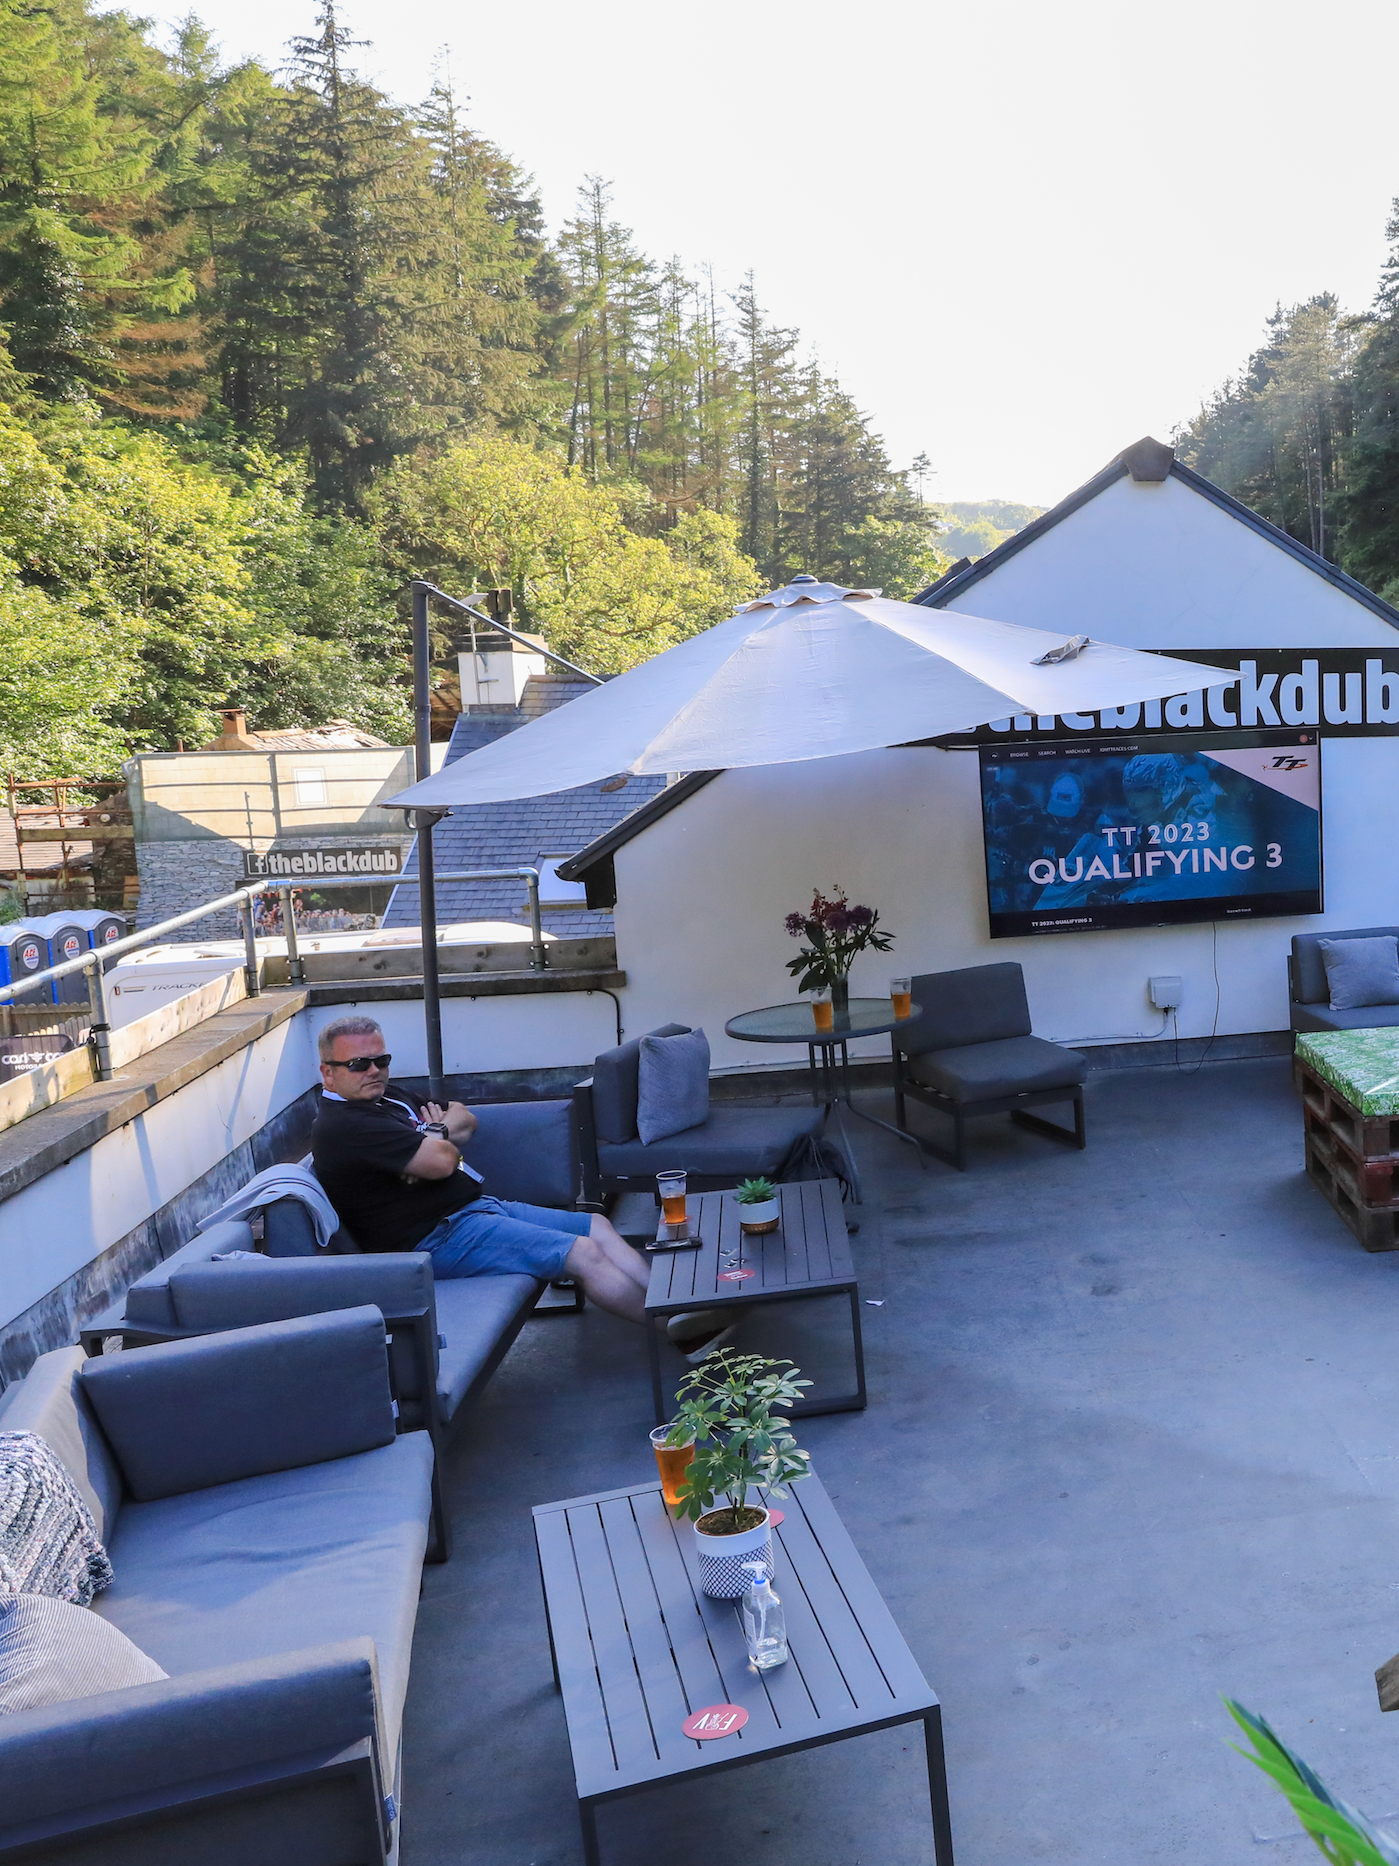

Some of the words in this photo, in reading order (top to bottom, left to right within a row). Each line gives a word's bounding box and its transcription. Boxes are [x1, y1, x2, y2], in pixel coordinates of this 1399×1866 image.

[1101, 826, 1137, 847] TT
[1147, 821, 1210, 845] 2023
[269, 850, 397, 874] theblackdub
[1028, 844, 1256, 885] QUALIFYING
[1265, 842, 1283, 868] 3
[1055, 918, 1088, 926] QUALIFYING
